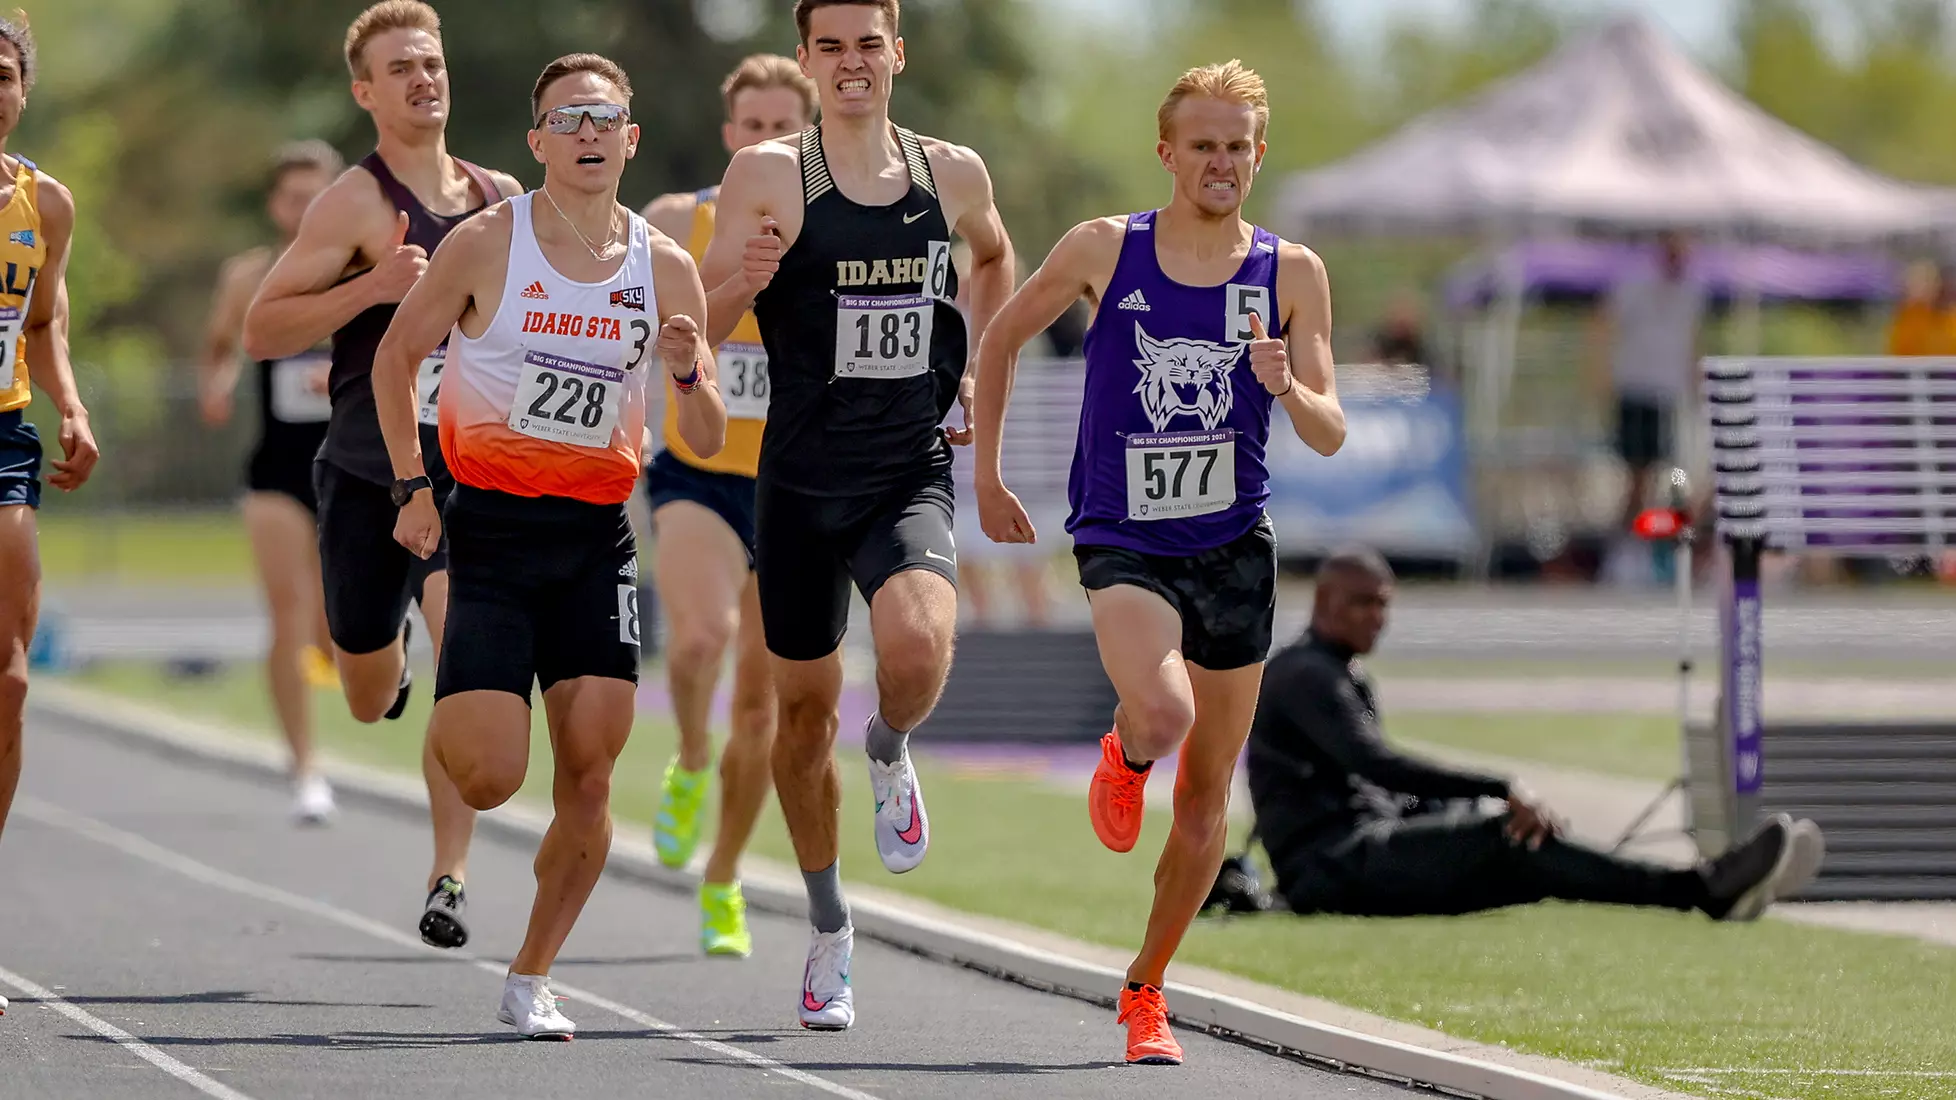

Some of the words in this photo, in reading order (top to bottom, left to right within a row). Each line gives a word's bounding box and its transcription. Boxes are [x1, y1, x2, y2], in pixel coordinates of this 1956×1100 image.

[837, 257, 929, 286] IDAHO
[931, 245, 947, 296] 6
[520, 291, 549, 300] adidas
[622, 288, 644, 304] SKY
[871, 297, 915, 306] CHAMPIONSHIPS
[1118, 301, 1151, 312] adidas
[522, 311, 583, 337] IDAHO
[586, 316, 621, 341] STA
[1237, 289, 1262, 341] 5
[625, 318, 650, 370] 3
[854, 311, 920, 360] 183
[532, 354, 544, 363] BIG
[545, 357, 557, 366] SKY
[557, 360, 605, 376] CHAMPIONSHIPS
[605, 370, 618, 378] 2021
[527, 372, 606, 428] 228
[531, 423, 552, 433] WEBER
[552, 427, 569, 437] STATE
[1158, 434, 1210, 444] CHAMPIONSHIPS
[1211, 433, 1226, 441] 2021
[1143, 449, 1218, 500] 577
